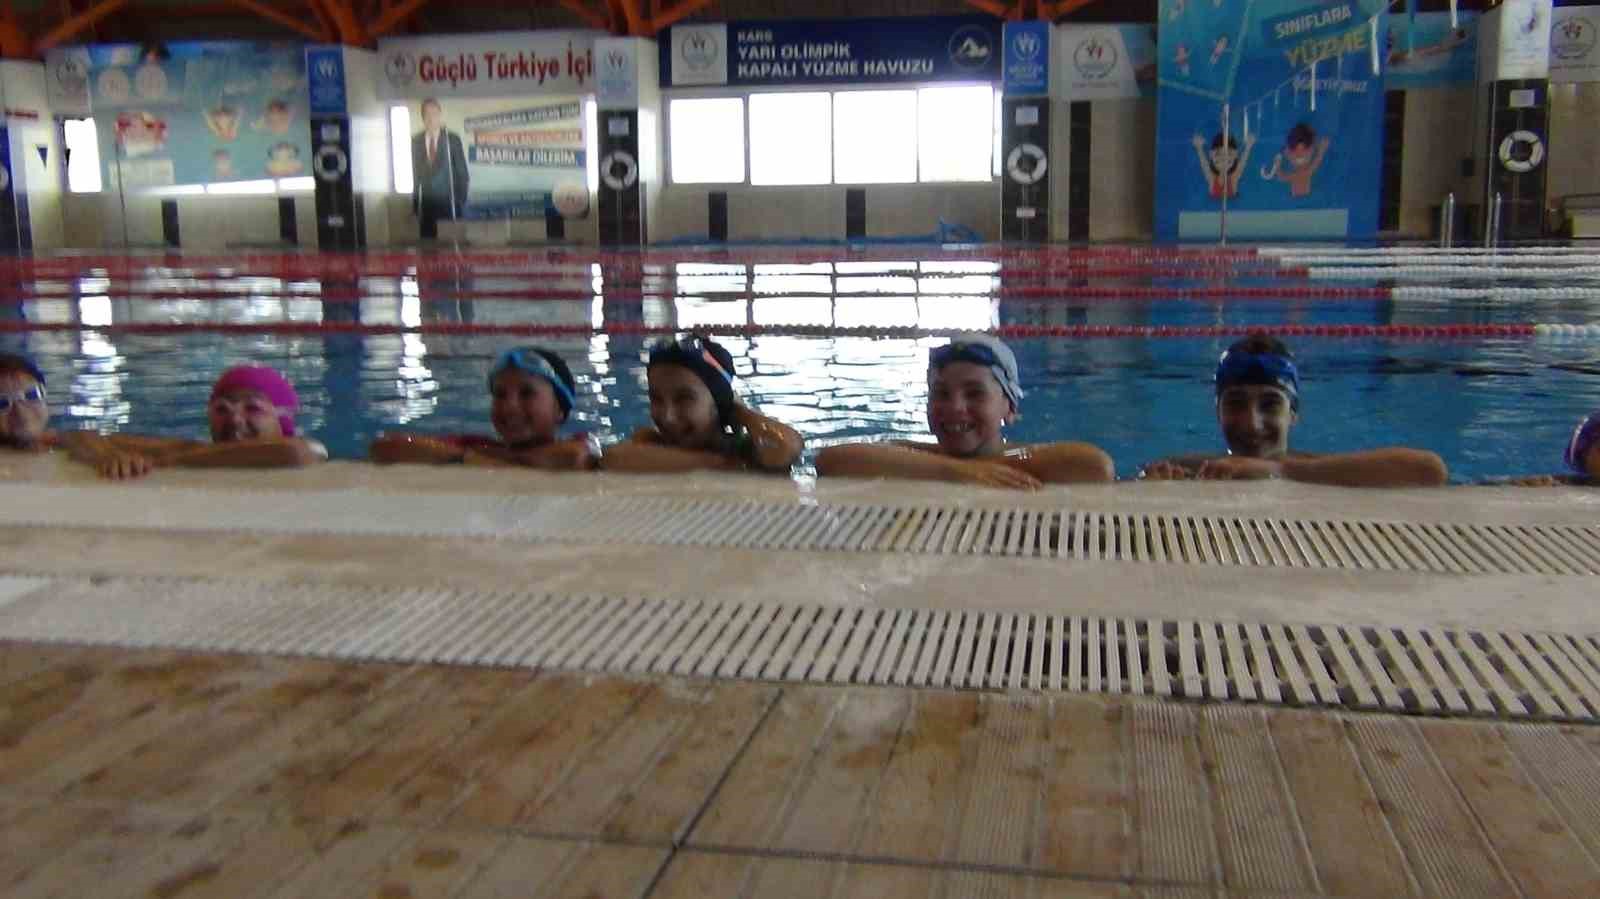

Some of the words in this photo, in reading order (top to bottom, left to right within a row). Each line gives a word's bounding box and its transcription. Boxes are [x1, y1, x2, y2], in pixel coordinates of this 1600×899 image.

[1274, 5, 1352, 39] SINIFLARA
[419, 53, 477, 88] Güçlü
[484, 50, 560, 86] Türkiye
[566, 40, 593, 85] İçi
[738, 45, 776, 60] YARI
[781, 41, 850, 60] OLİMPİK
[738, 61, 797, 78] KAPALI
[802, 59, 859, 76] YÜZME
[864, 58, 934, 75] HAVUZU
